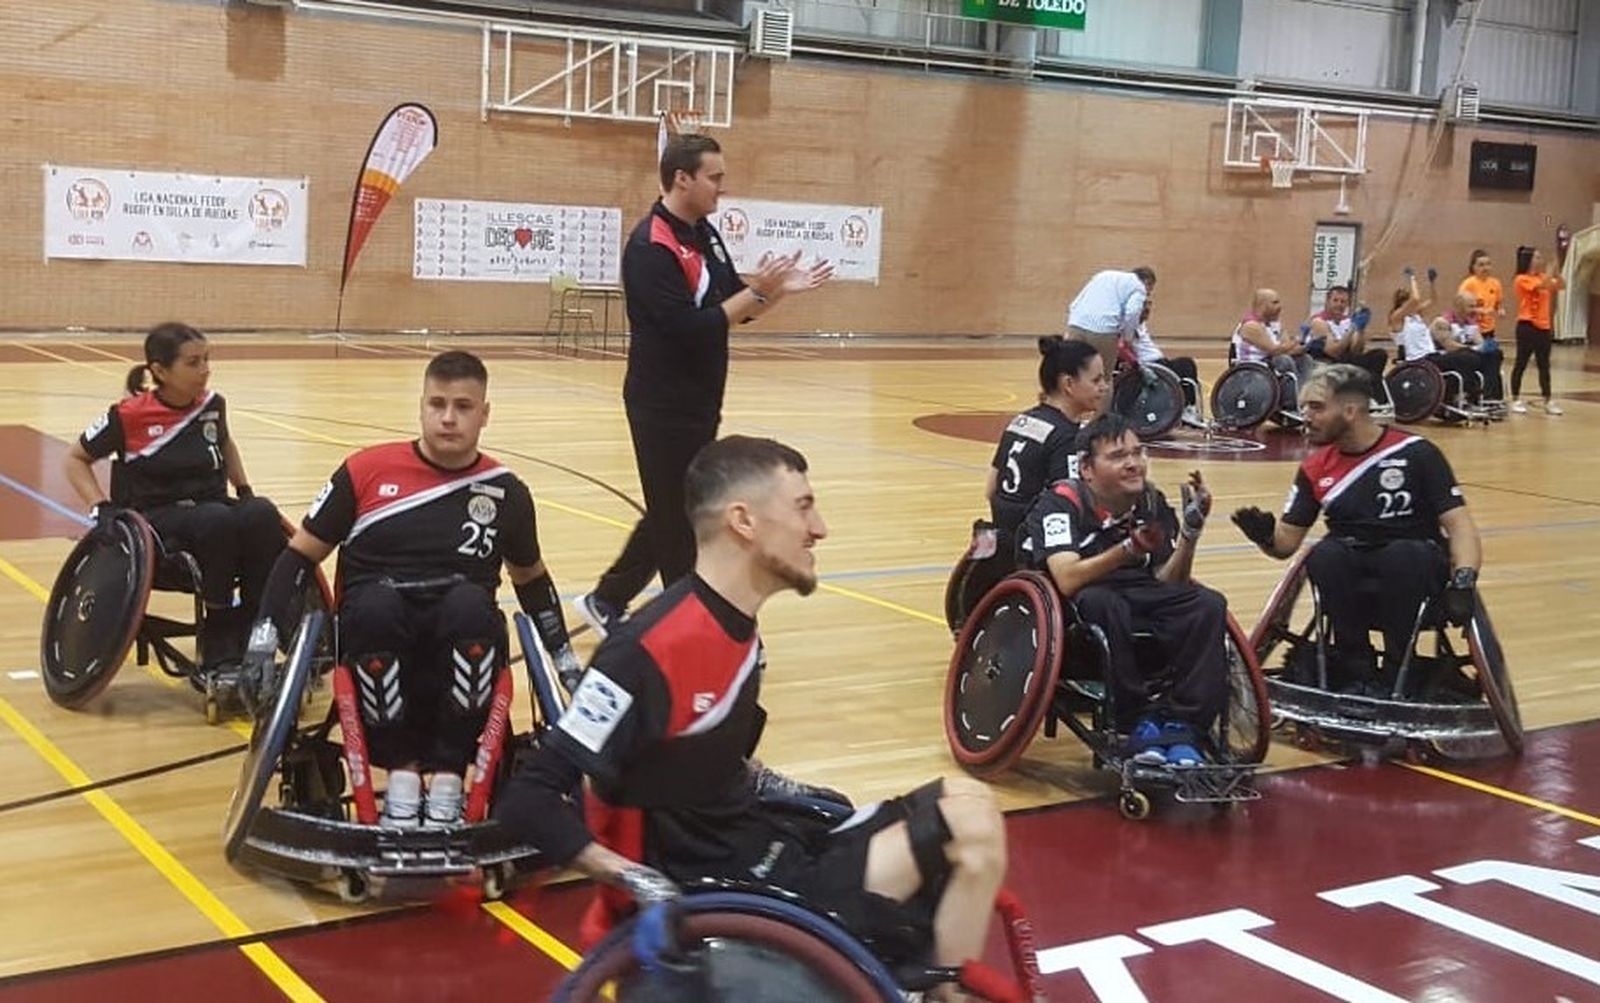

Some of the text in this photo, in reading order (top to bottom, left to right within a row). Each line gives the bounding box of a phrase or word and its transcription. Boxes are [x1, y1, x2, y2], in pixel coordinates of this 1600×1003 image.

[1026, 0, 1086, 15] TOLEDO
[486, 212, 554, 225] ILLESCAS
[1313, 236, 1326, 273] salida
[1002, 440, 1027, 493] 5
[1377, 491, 1414, 519] 22
[458, 521, 498, 558] 25
